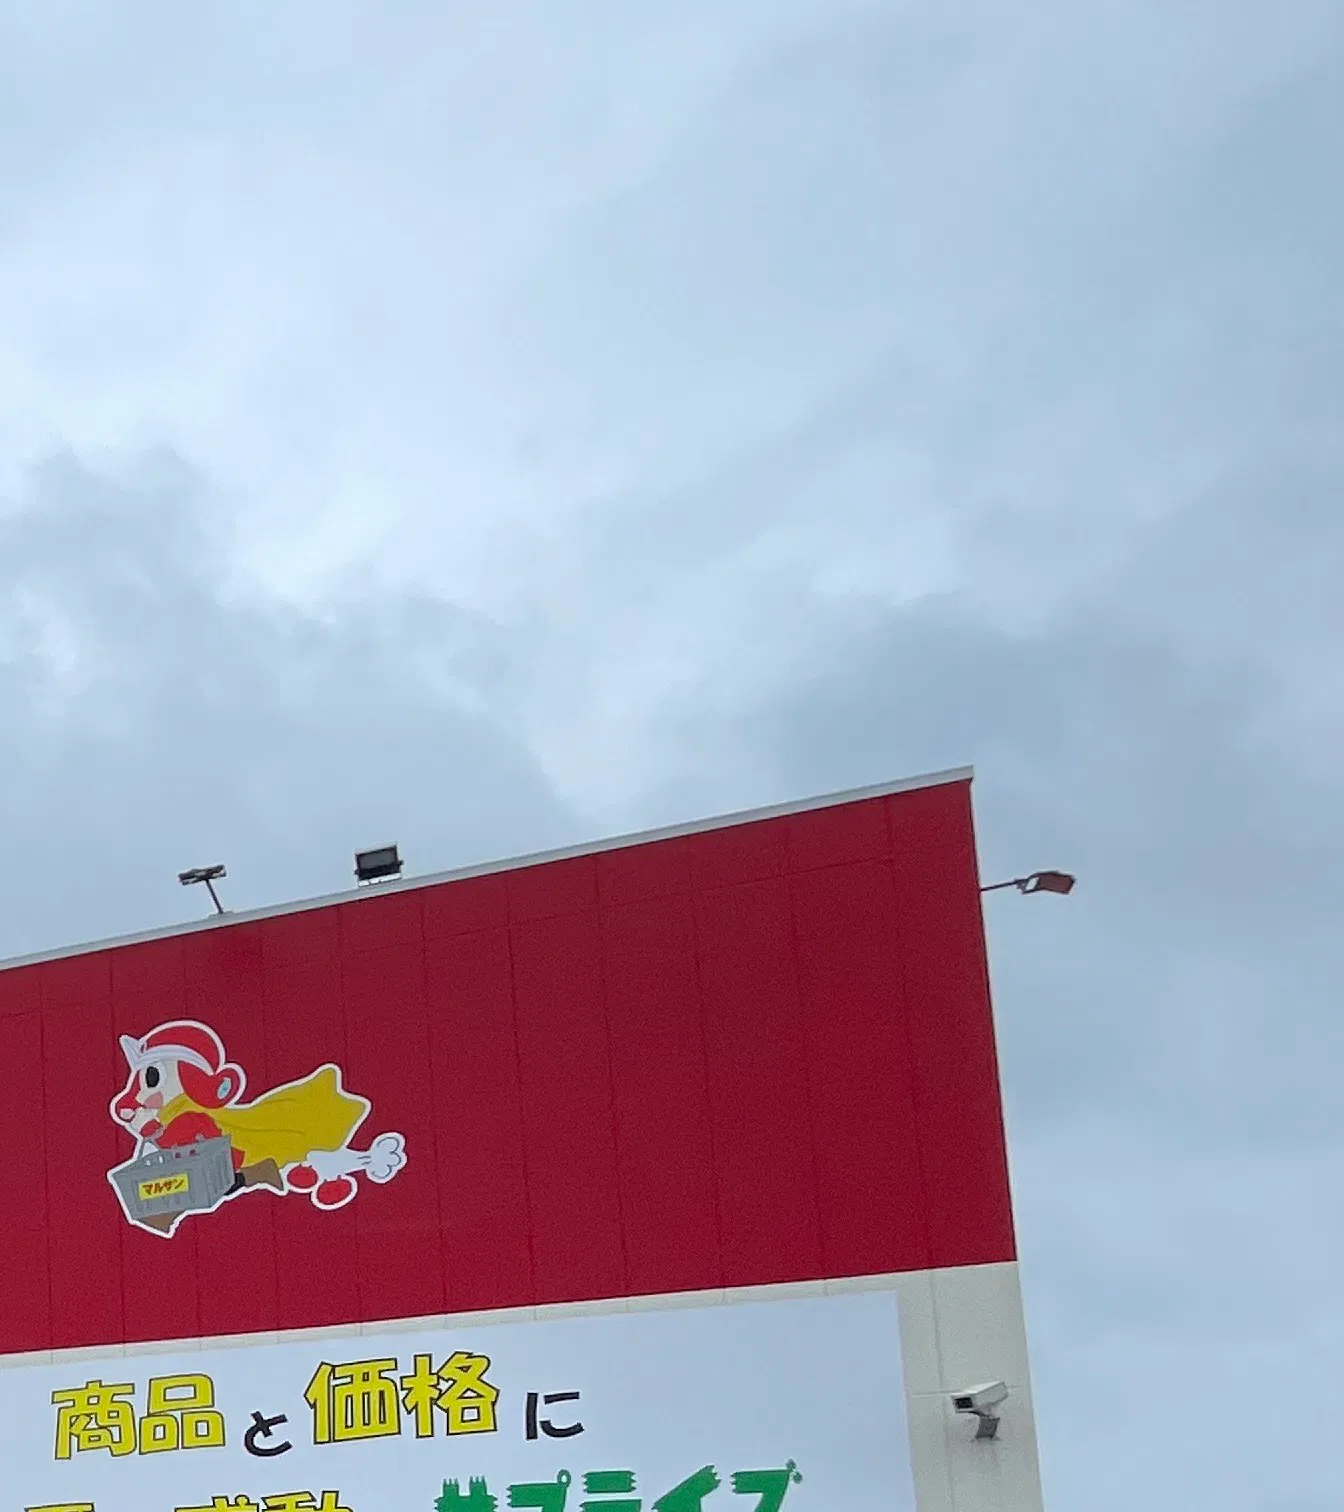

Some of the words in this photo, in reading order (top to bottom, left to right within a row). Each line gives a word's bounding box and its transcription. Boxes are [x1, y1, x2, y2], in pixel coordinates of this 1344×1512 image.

[142, 1177, 185, 1194] マルサン
[51, 1350, 585, 1460] 商品と価格に
